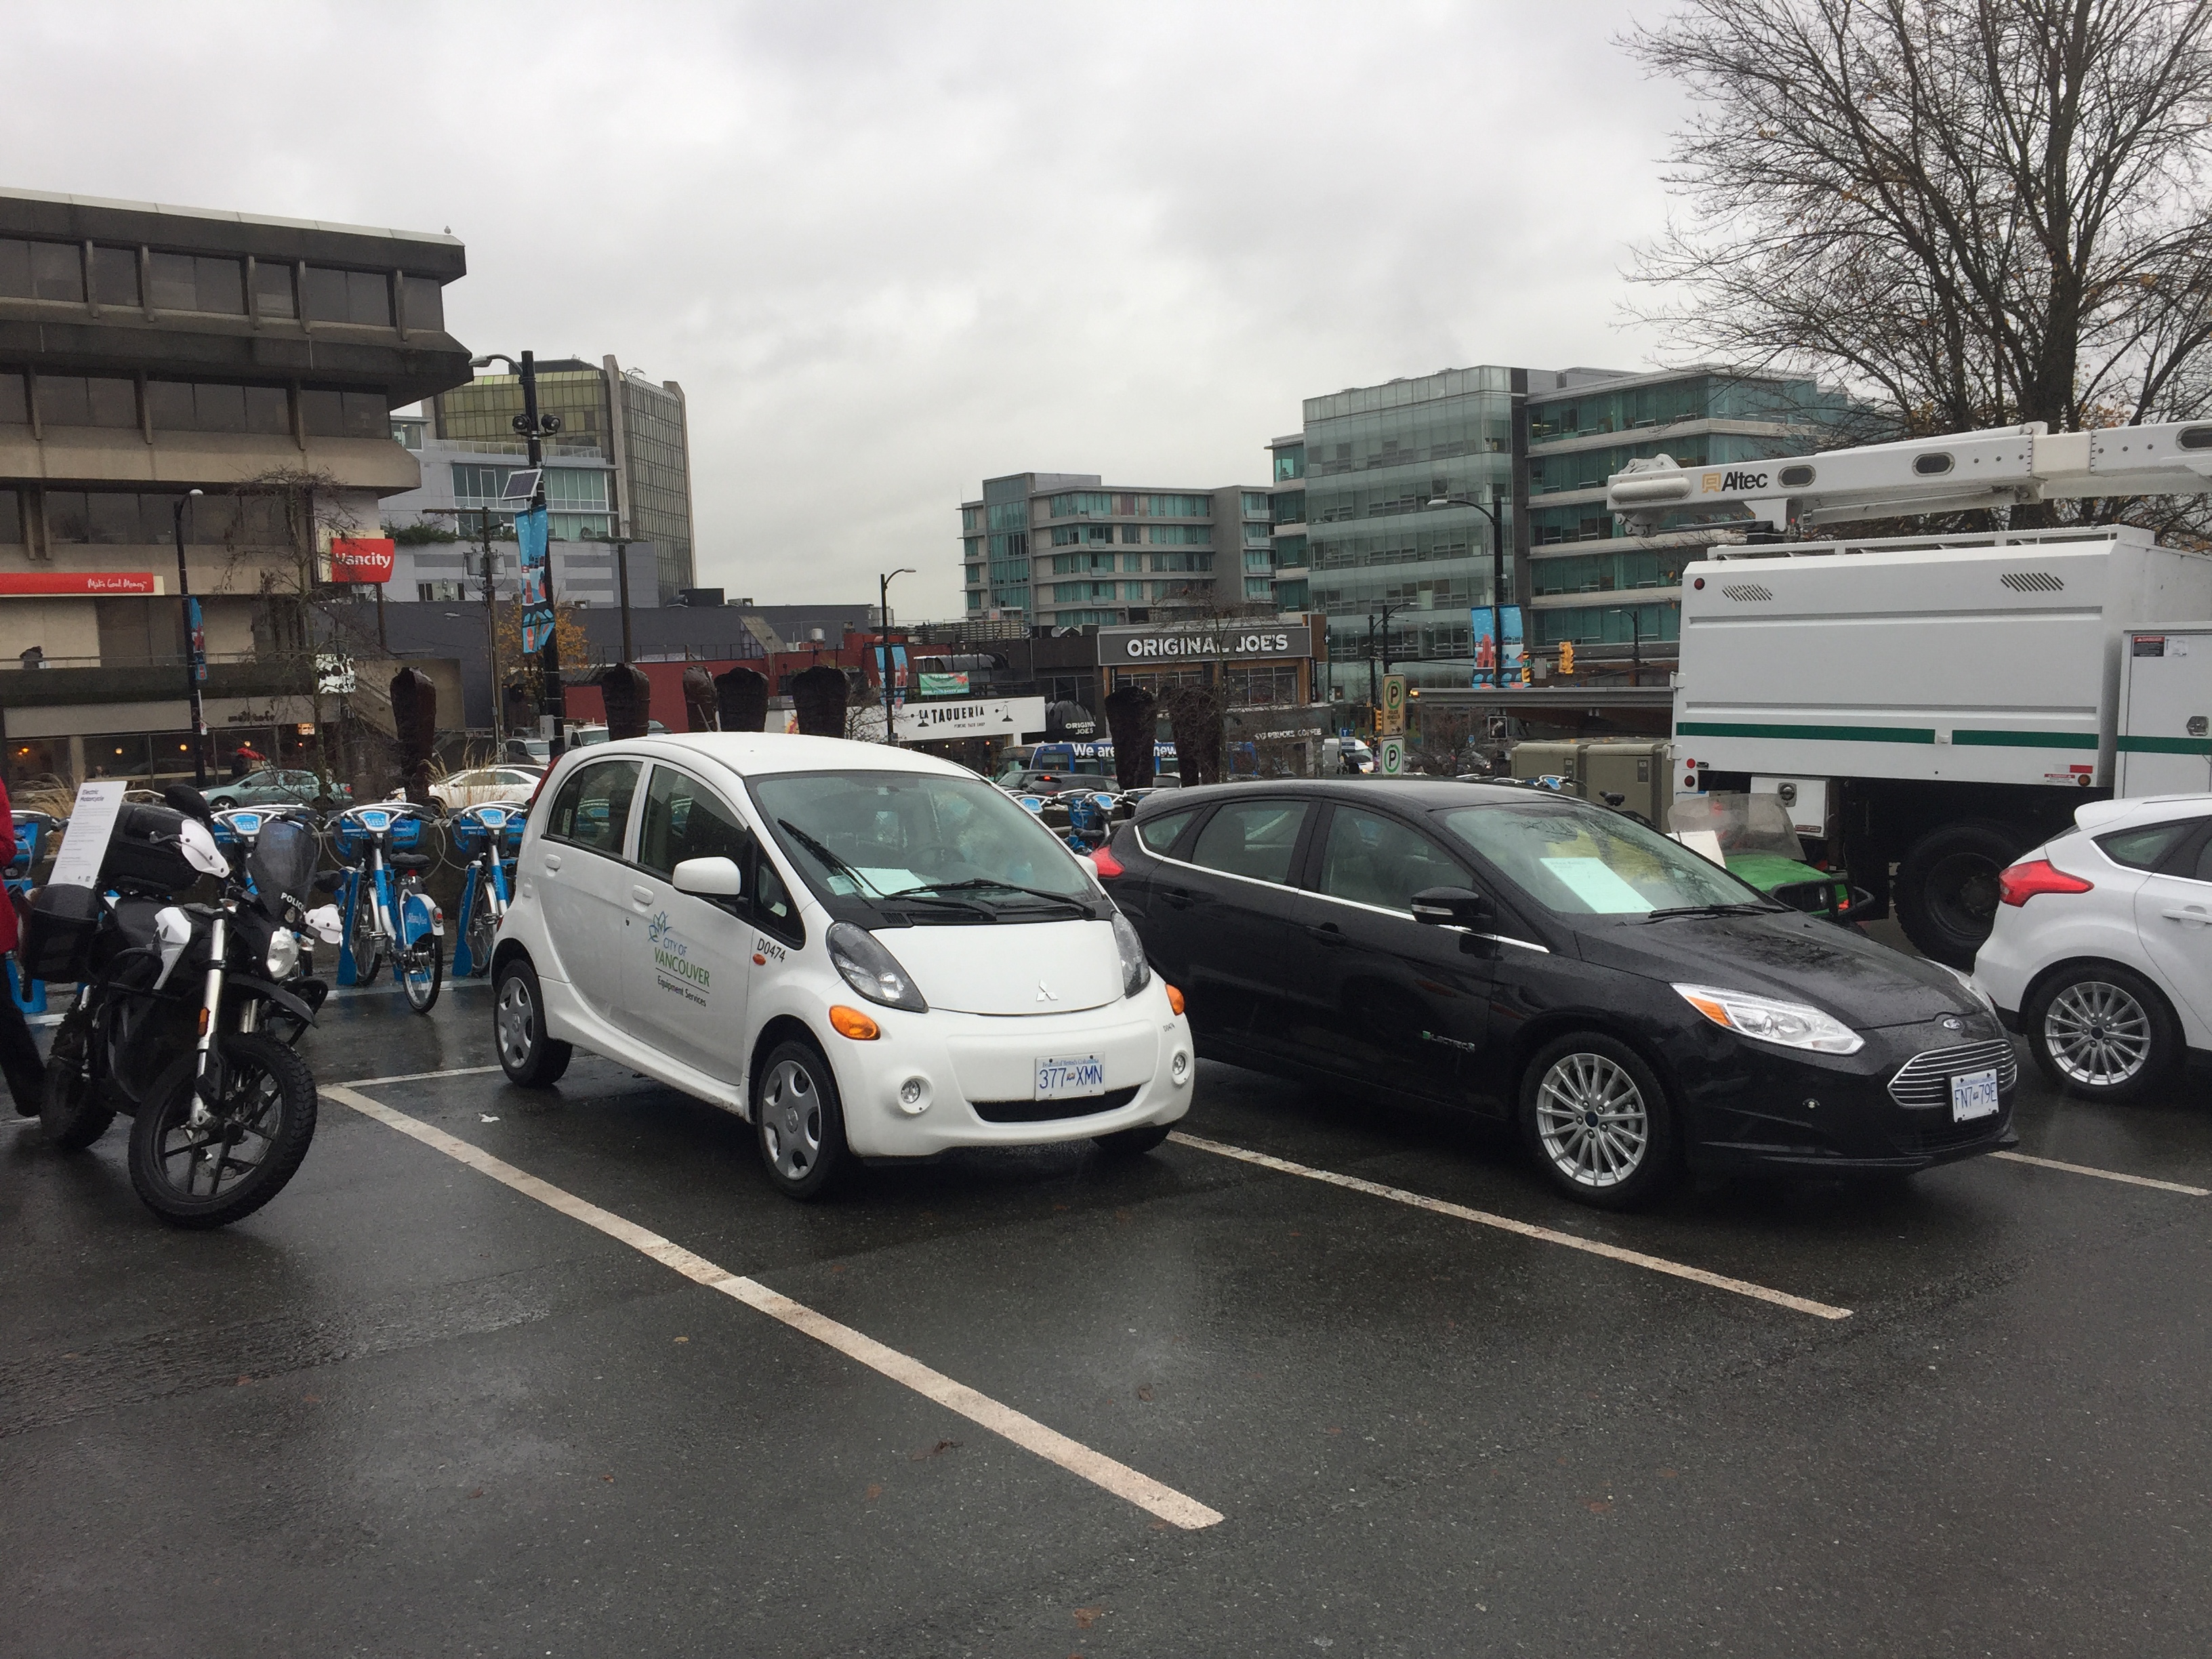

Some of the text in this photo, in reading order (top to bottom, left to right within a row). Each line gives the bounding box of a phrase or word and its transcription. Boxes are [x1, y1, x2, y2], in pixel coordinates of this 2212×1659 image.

[1721, 471, 1768, 491] Altec
[335, 552, 391, 569] Vancity
[87, 578, 105, 590] Make
[107, 579, 122, 588] Good
[1127, 634, 1288, 657] ORIGINAL JOE'S
[1391, 686, 1398, 703] P
[919, 710, 928, 719] LA
[1072, 743, 1115, 758] We are
[1389, 750, 1396, 767] P
[281, 892, 304, 912] POLICE
[663, 937, 687, 957] CITY OF
[757, 938, 786, 963] D0474
[654, 947, 710, 987] VANCOUVER
[657, 975, 706, 1008] Equipment Services
[1039, 1064, 1102, 1089] 377 XMN
[1954, 1086, 1972, 1109] FN7
[1979, 1082, 1996, 1105] 79E
